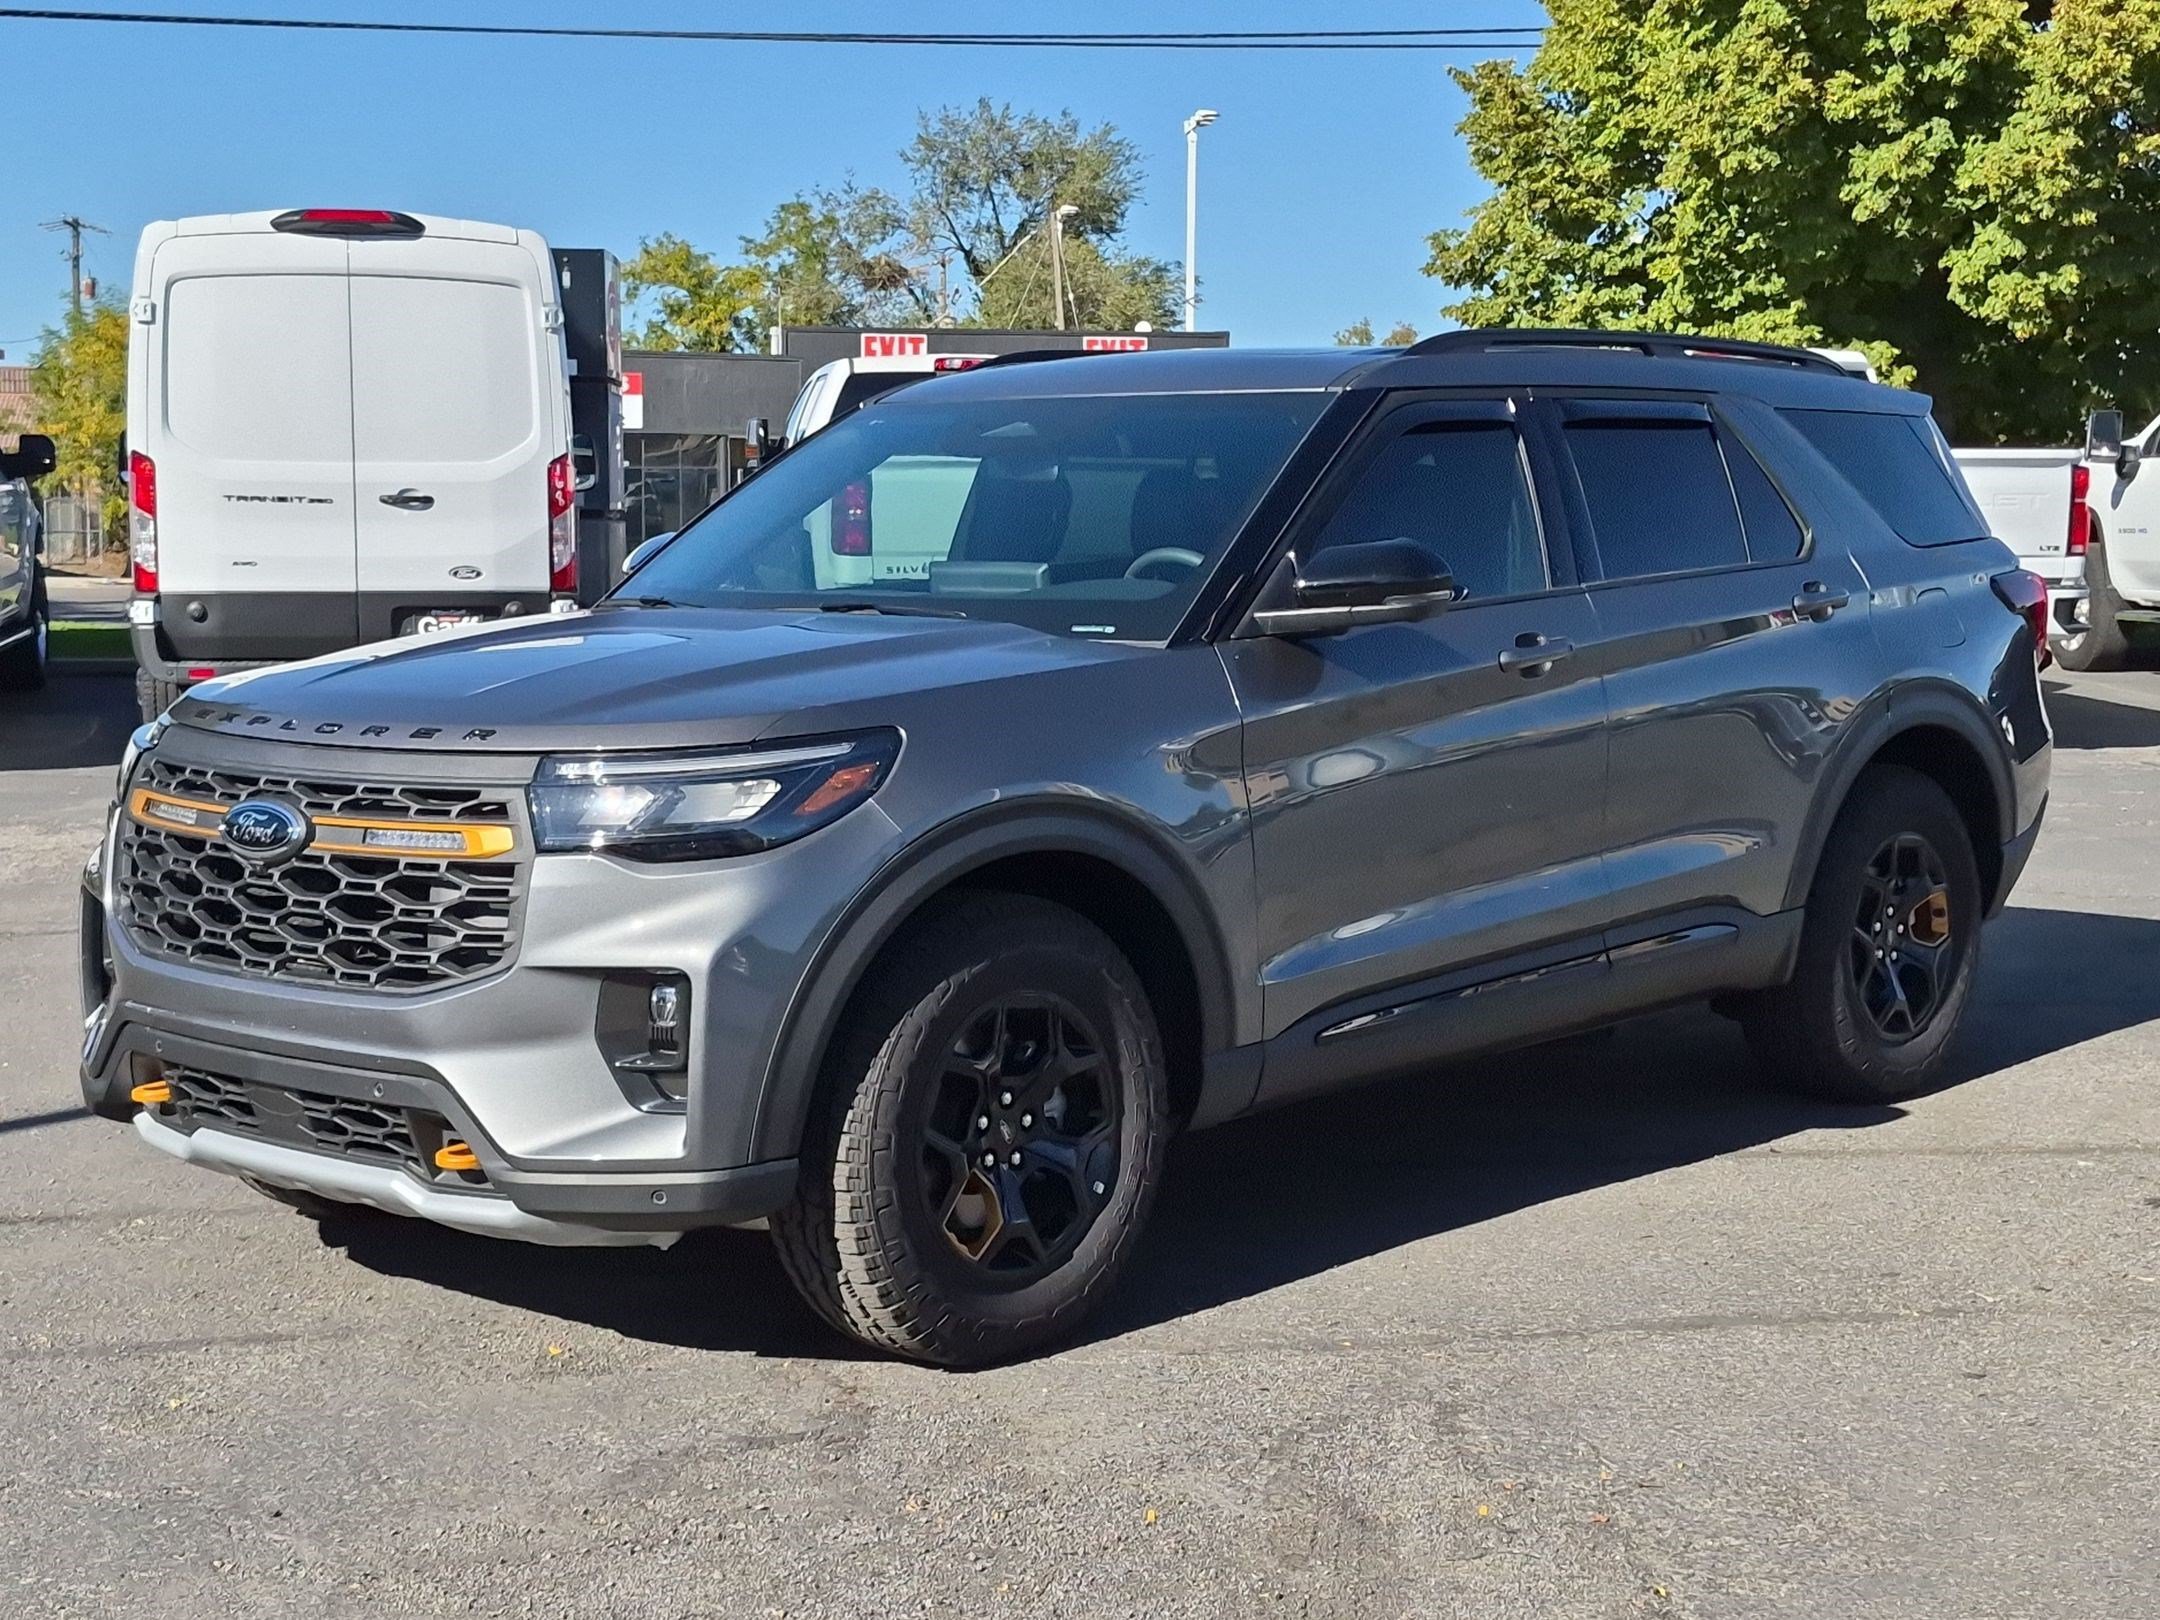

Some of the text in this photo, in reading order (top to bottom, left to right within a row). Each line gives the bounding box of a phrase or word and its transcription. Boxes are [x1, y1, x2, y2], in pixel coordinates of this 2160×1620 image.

[222, 494, 306, 503] TRANSIT
[194, 708, 497, 742] EXPLORER
[231, 808, 284, 845] Ford
